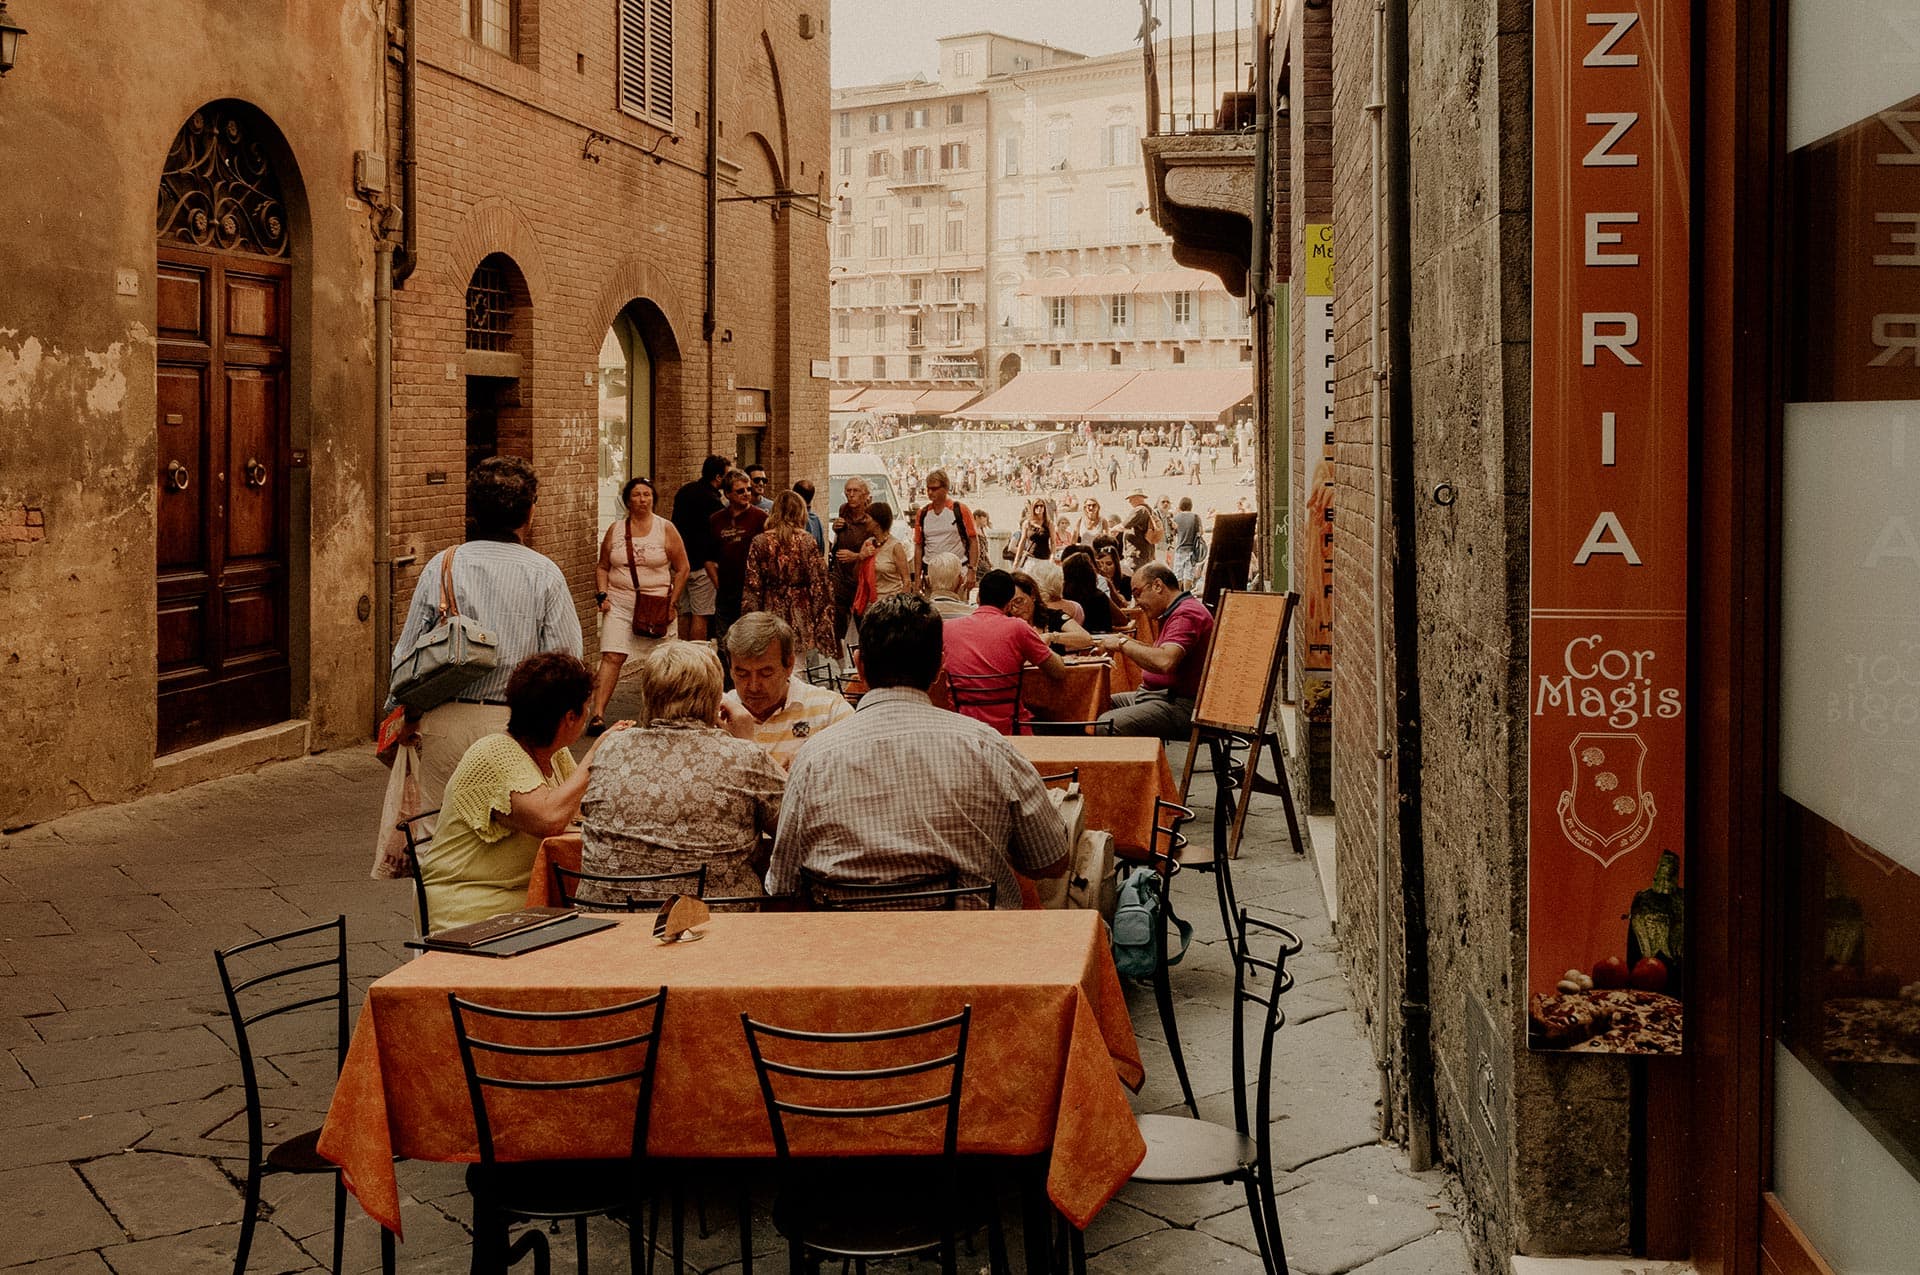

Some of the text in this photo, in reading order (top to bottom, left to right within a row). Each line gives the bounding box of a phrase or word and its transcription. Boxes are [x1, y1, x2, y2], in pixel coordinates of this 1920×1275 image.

[1573, 13, 1643, 565] ZZERIA
[1564, 634, 1656, 681] Cor
[1534, 674, 1683, 730] Magis
